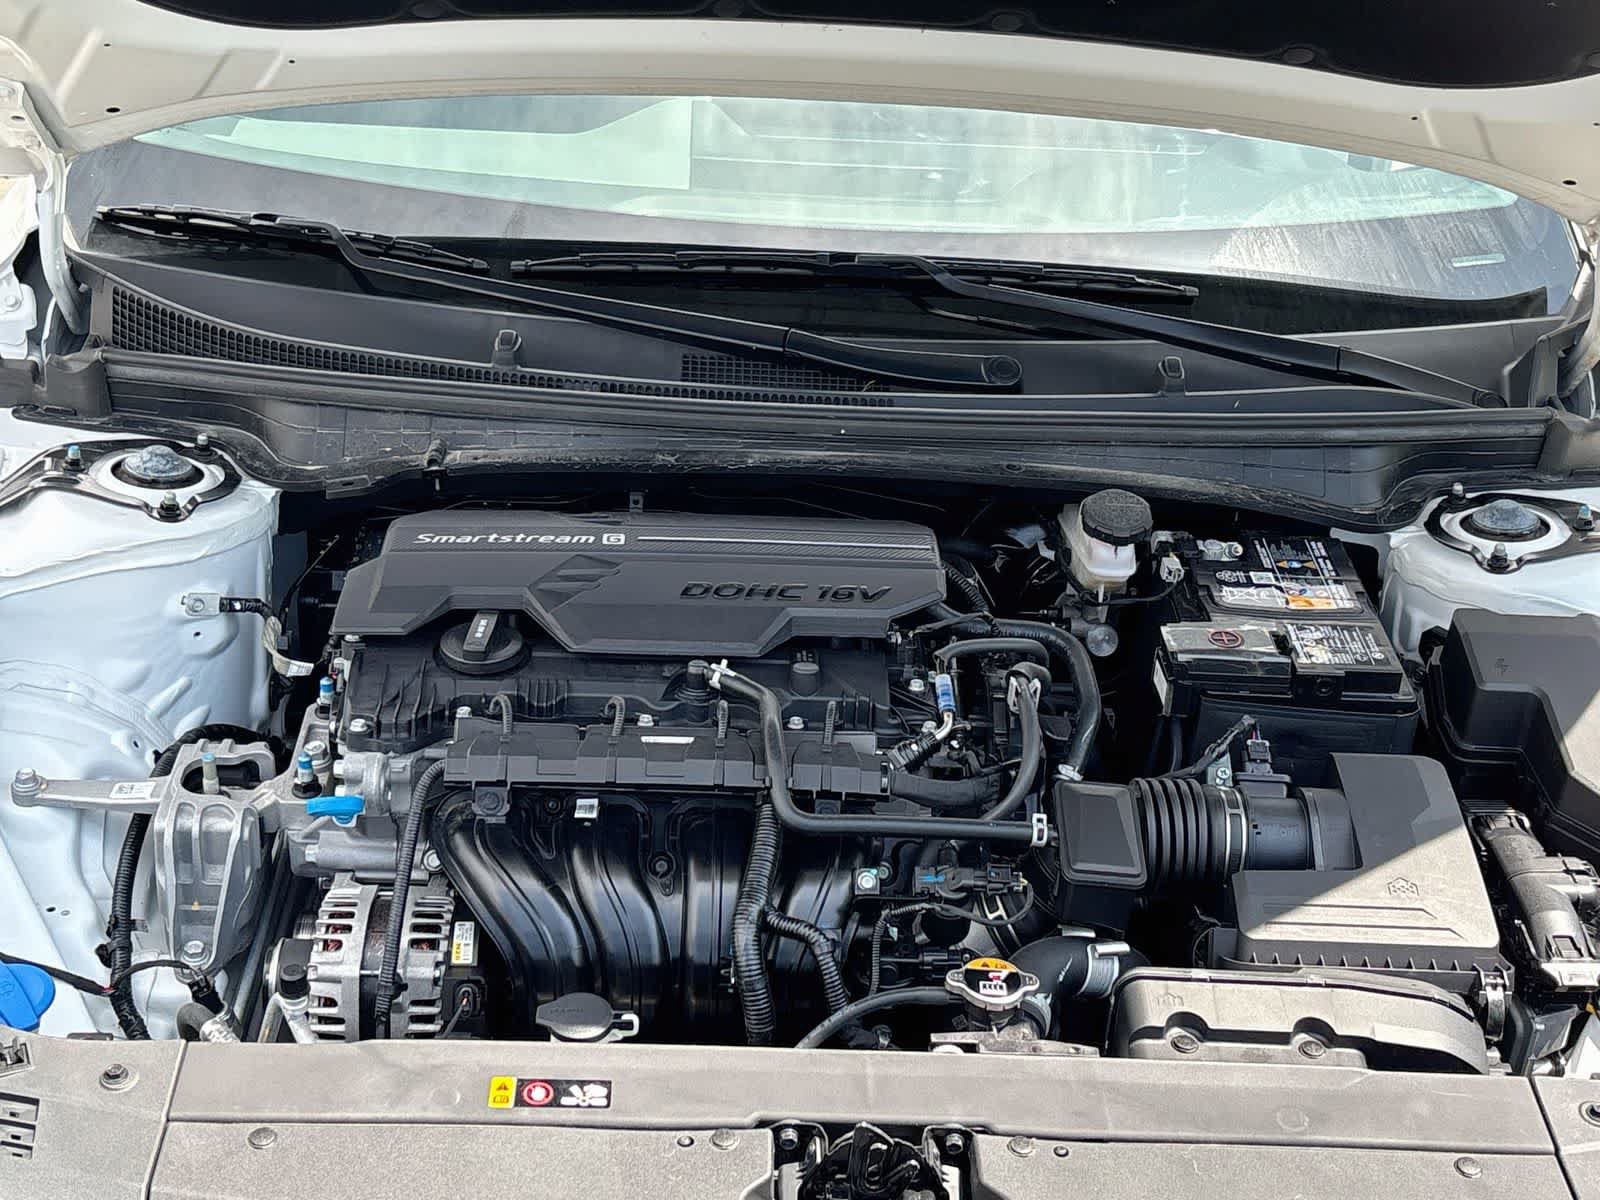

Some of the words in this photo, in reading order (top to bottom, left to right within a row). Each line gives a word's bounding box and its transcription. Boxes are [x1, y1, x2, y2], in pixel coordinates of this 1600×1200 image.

[413, 532, 596, 545] Smartstream
[602, 533, 626, 545] G
[680, 581, 809, 601] DOHC
[815, 584, 893, 603] 16V
